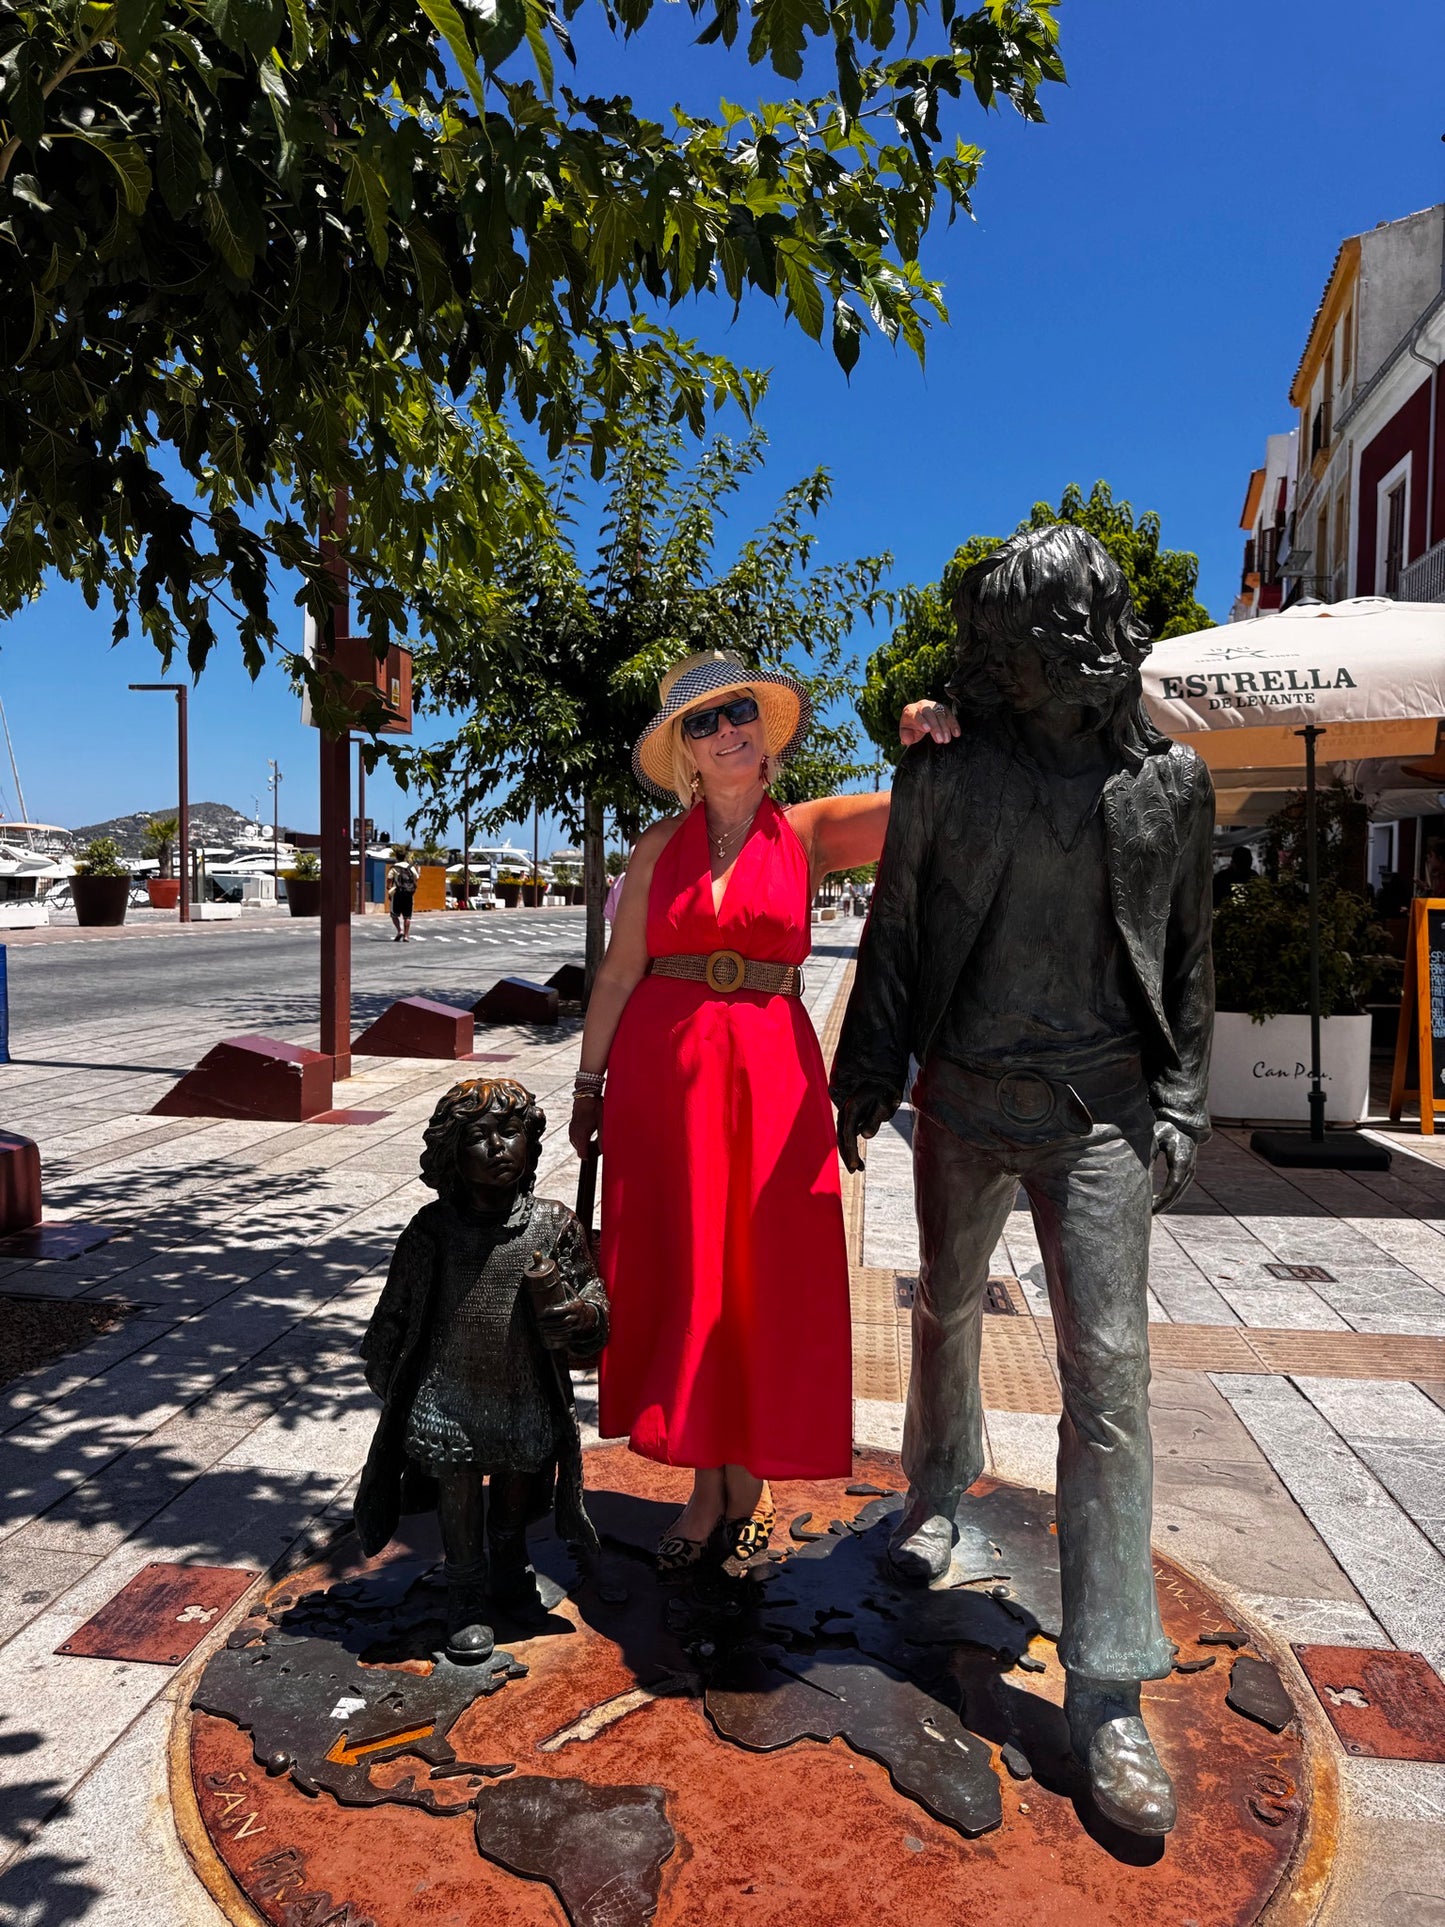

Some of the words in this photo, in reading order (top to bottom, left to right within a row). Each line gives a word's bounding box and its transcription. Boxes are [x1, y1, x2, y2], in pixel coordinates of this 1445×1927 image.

[1159, 667, 1357, 699] ESTRELLA
[1208, 698, 1231, 710] DE
[1236, 693, 1316, 708] LEVANTE
[1253, 1061, 1289, 1078] Can
[204, 1771, 267, 1840] SAN
